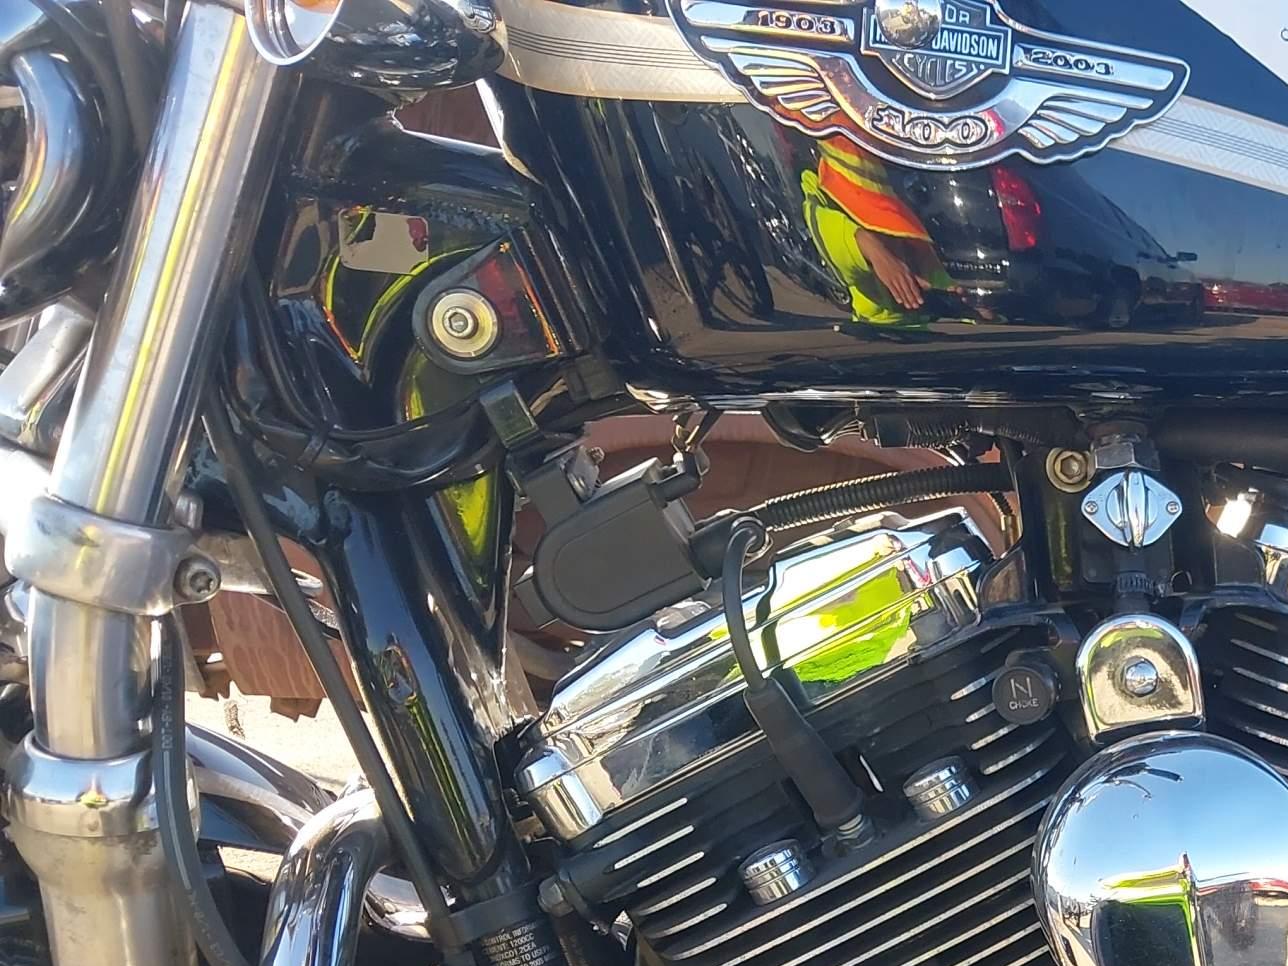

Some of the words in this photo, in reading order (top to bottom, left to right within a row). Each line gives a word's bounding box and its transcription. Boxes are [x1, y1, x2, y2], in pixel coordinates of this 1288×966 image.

[758, 11, 841, 36] 1903
[904, 51, 968, 86] CYCLES
[1030, 49, 1114, 76] 2003
[509, 932, 534, 947] 1200CC
[520, 953, 530, 961] TO
